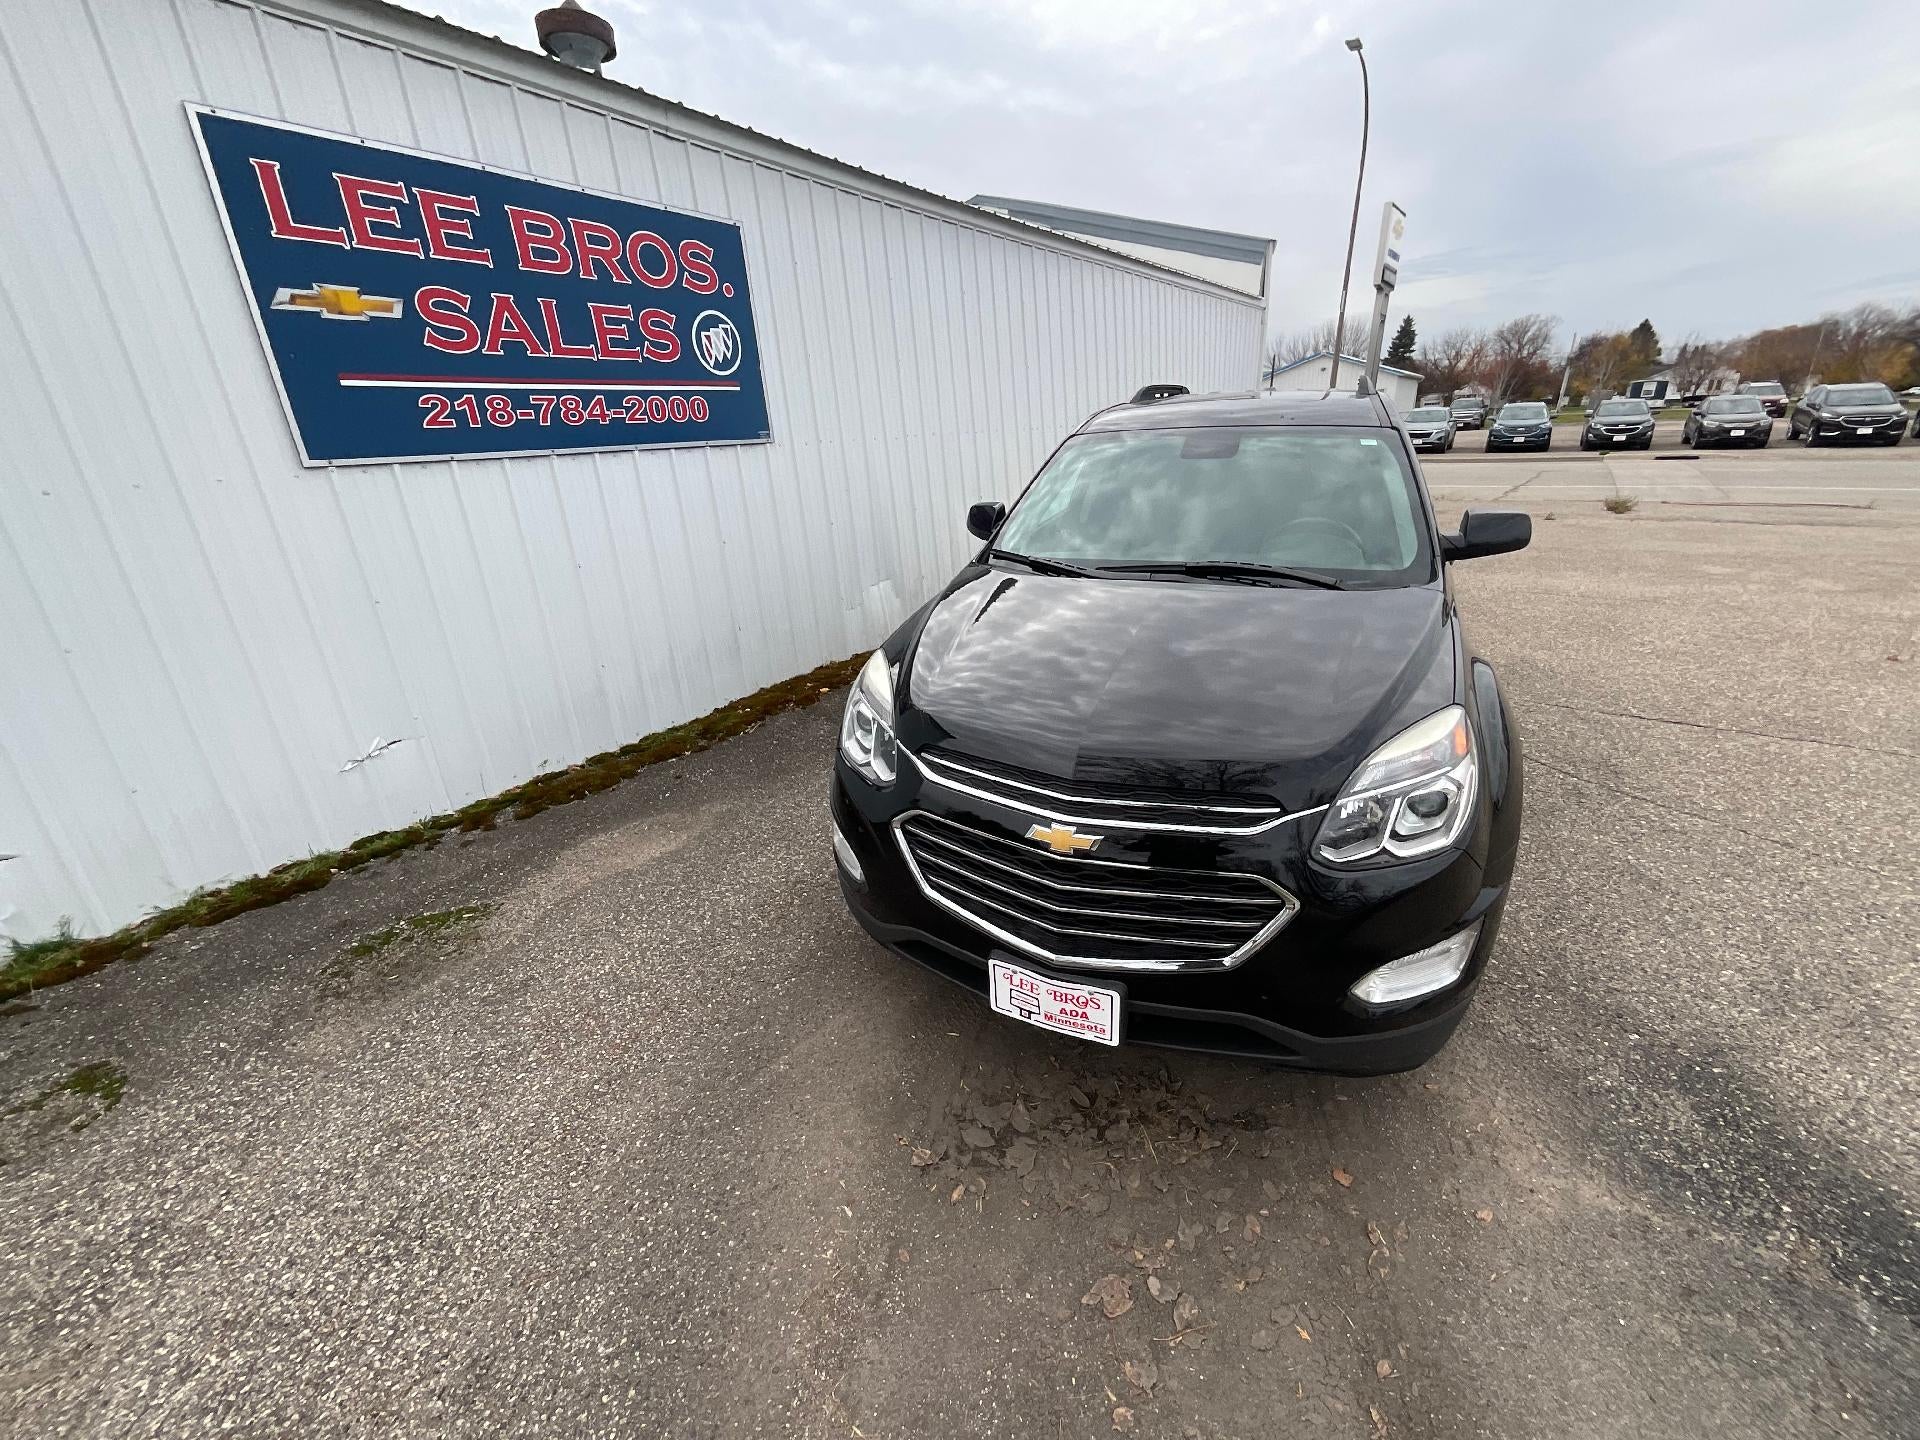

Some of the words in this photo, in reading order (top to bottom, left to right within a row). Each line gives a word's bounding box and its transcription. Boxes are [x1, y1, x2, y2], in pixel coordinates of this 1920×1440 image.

[249, 158, 494, 268] LEE
[504, 204, 735, 299] BROS.
[415, 285, 681, 363] SALES
[418, 394, 709, 429] 218-784-2000
[1002, 972, 1041, 996] LEE
[1043, 1012, 1106, 1034] Minnesota
[1059, 1007, 1090, 1021] ADA
